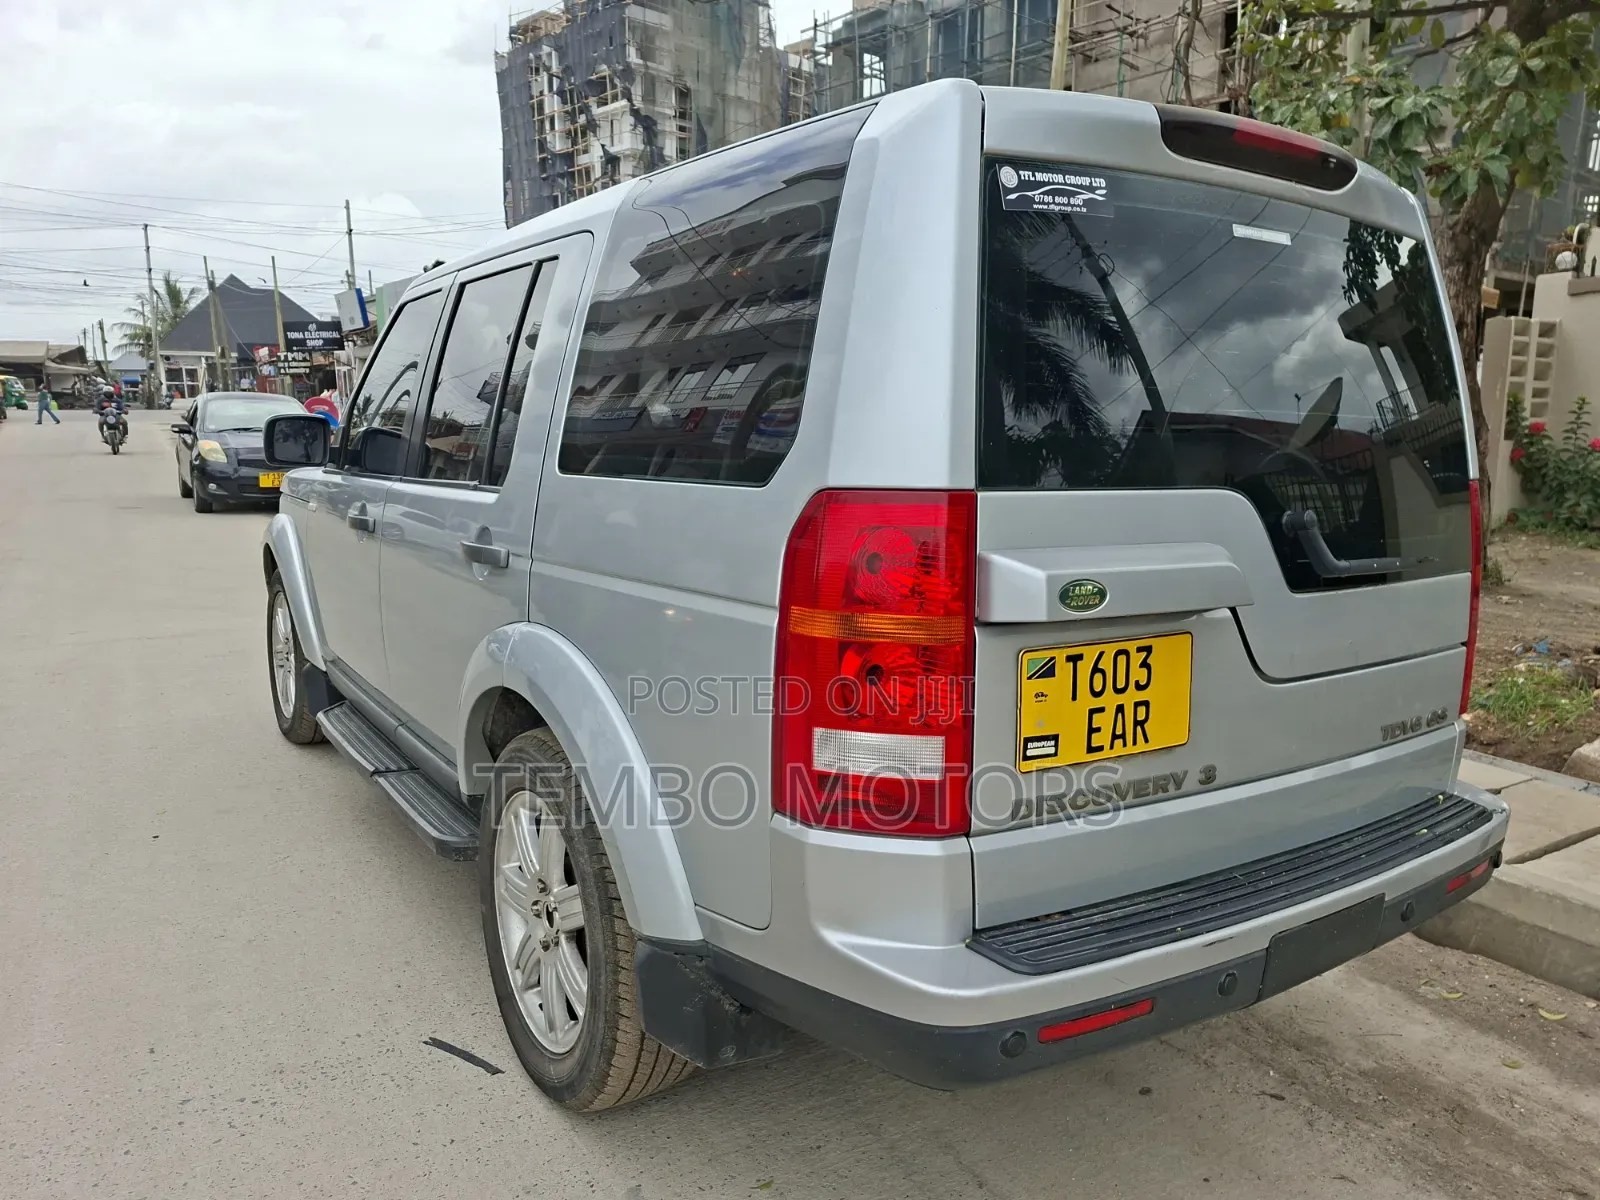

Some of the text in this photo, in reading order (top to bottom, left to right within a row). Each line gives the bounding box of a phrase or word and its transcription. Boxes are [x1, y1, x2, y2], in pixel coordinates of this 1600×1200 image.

[1019, 170, 1106, 187] TFL MOTOR GROUP LTD
[286, 330, 341, 339] TONA ELECTRICAL
[306, 339, 324, 347] SHOP
[277, 351, 310, 361] TMM
[1065, 645, 1153, 701] T603
[1086, 700, 1150, 754] EAR
[1027, 739, 1055, 749] EUROPEAN
[1197, 763, 1218, 786] 3
